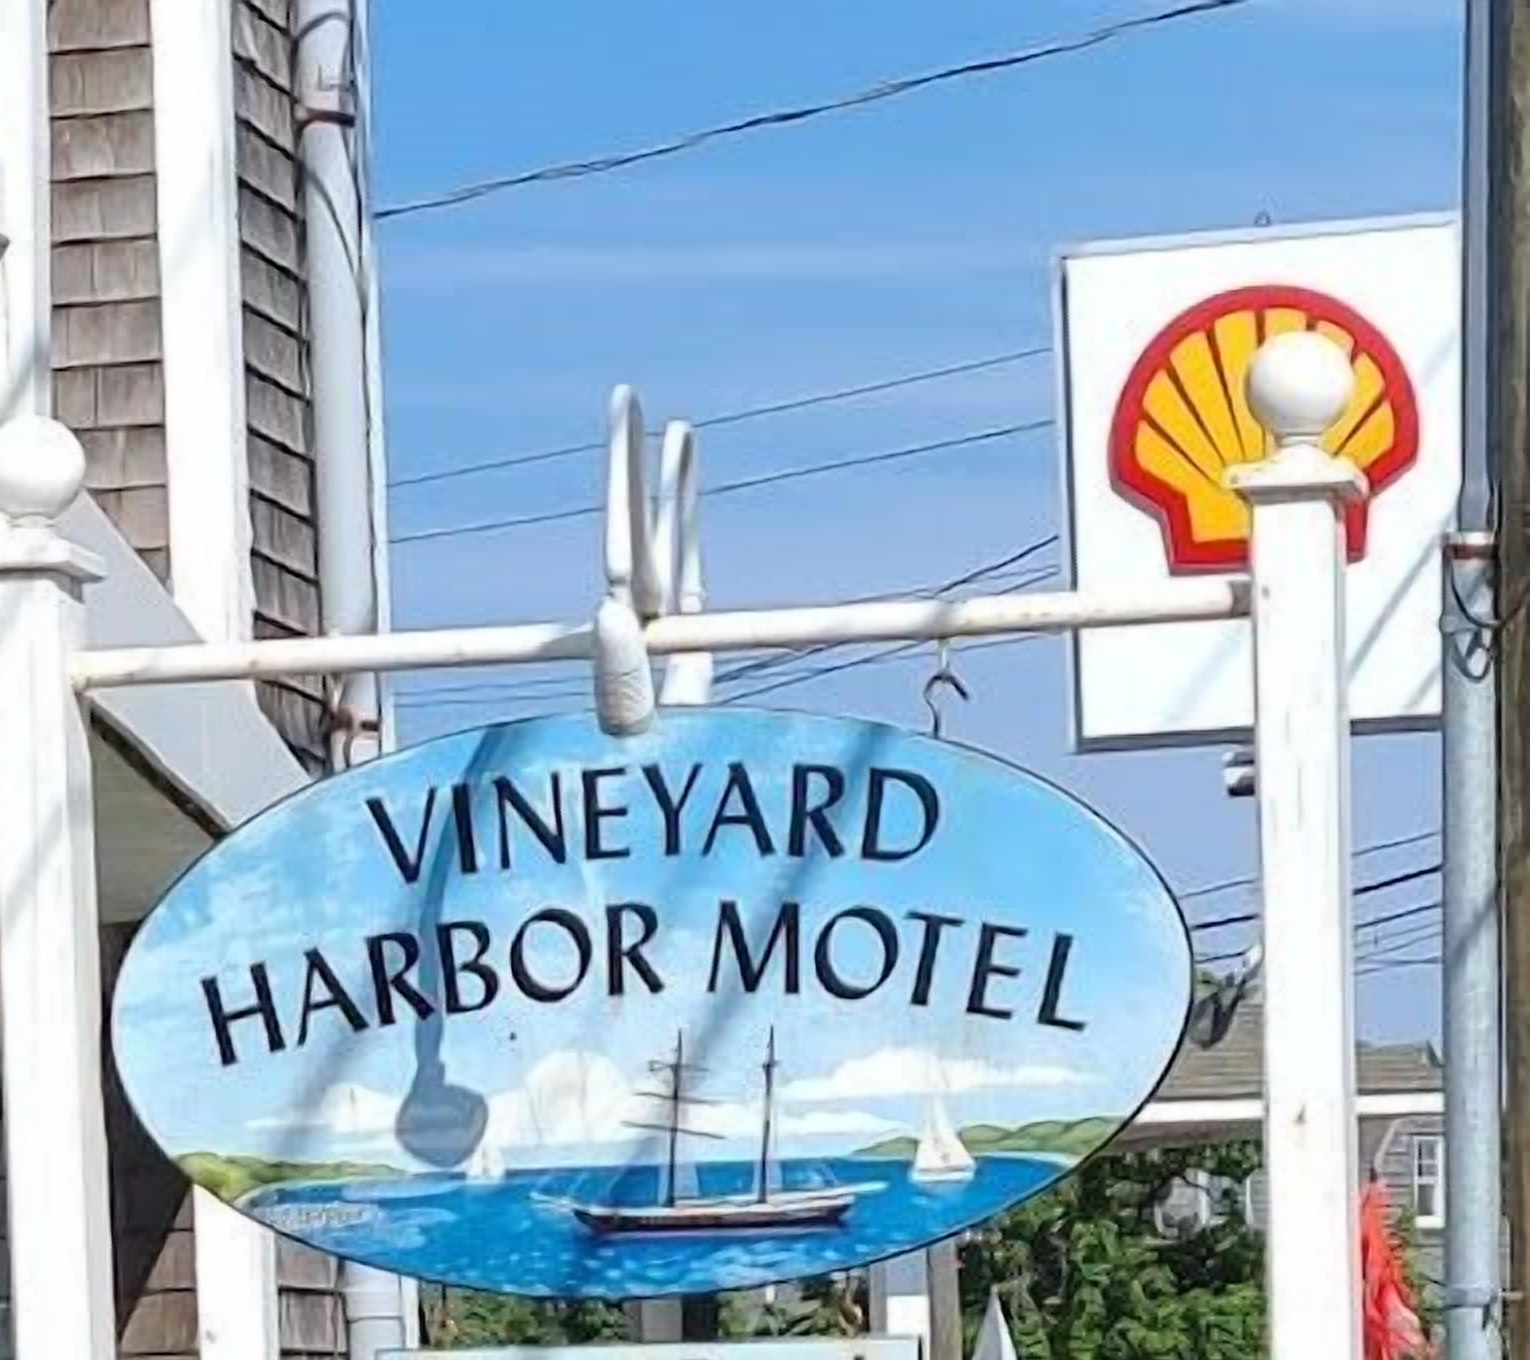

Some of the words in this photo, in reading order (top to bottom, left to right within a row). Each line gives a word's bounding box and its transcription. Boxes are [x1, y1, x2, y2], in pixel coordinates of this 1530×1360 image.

[367, 762, 940, 884] VINEYARD
[201, 903, 666, 1066] HARBOR
[706, 900, 1088, 1031] MOTEL
